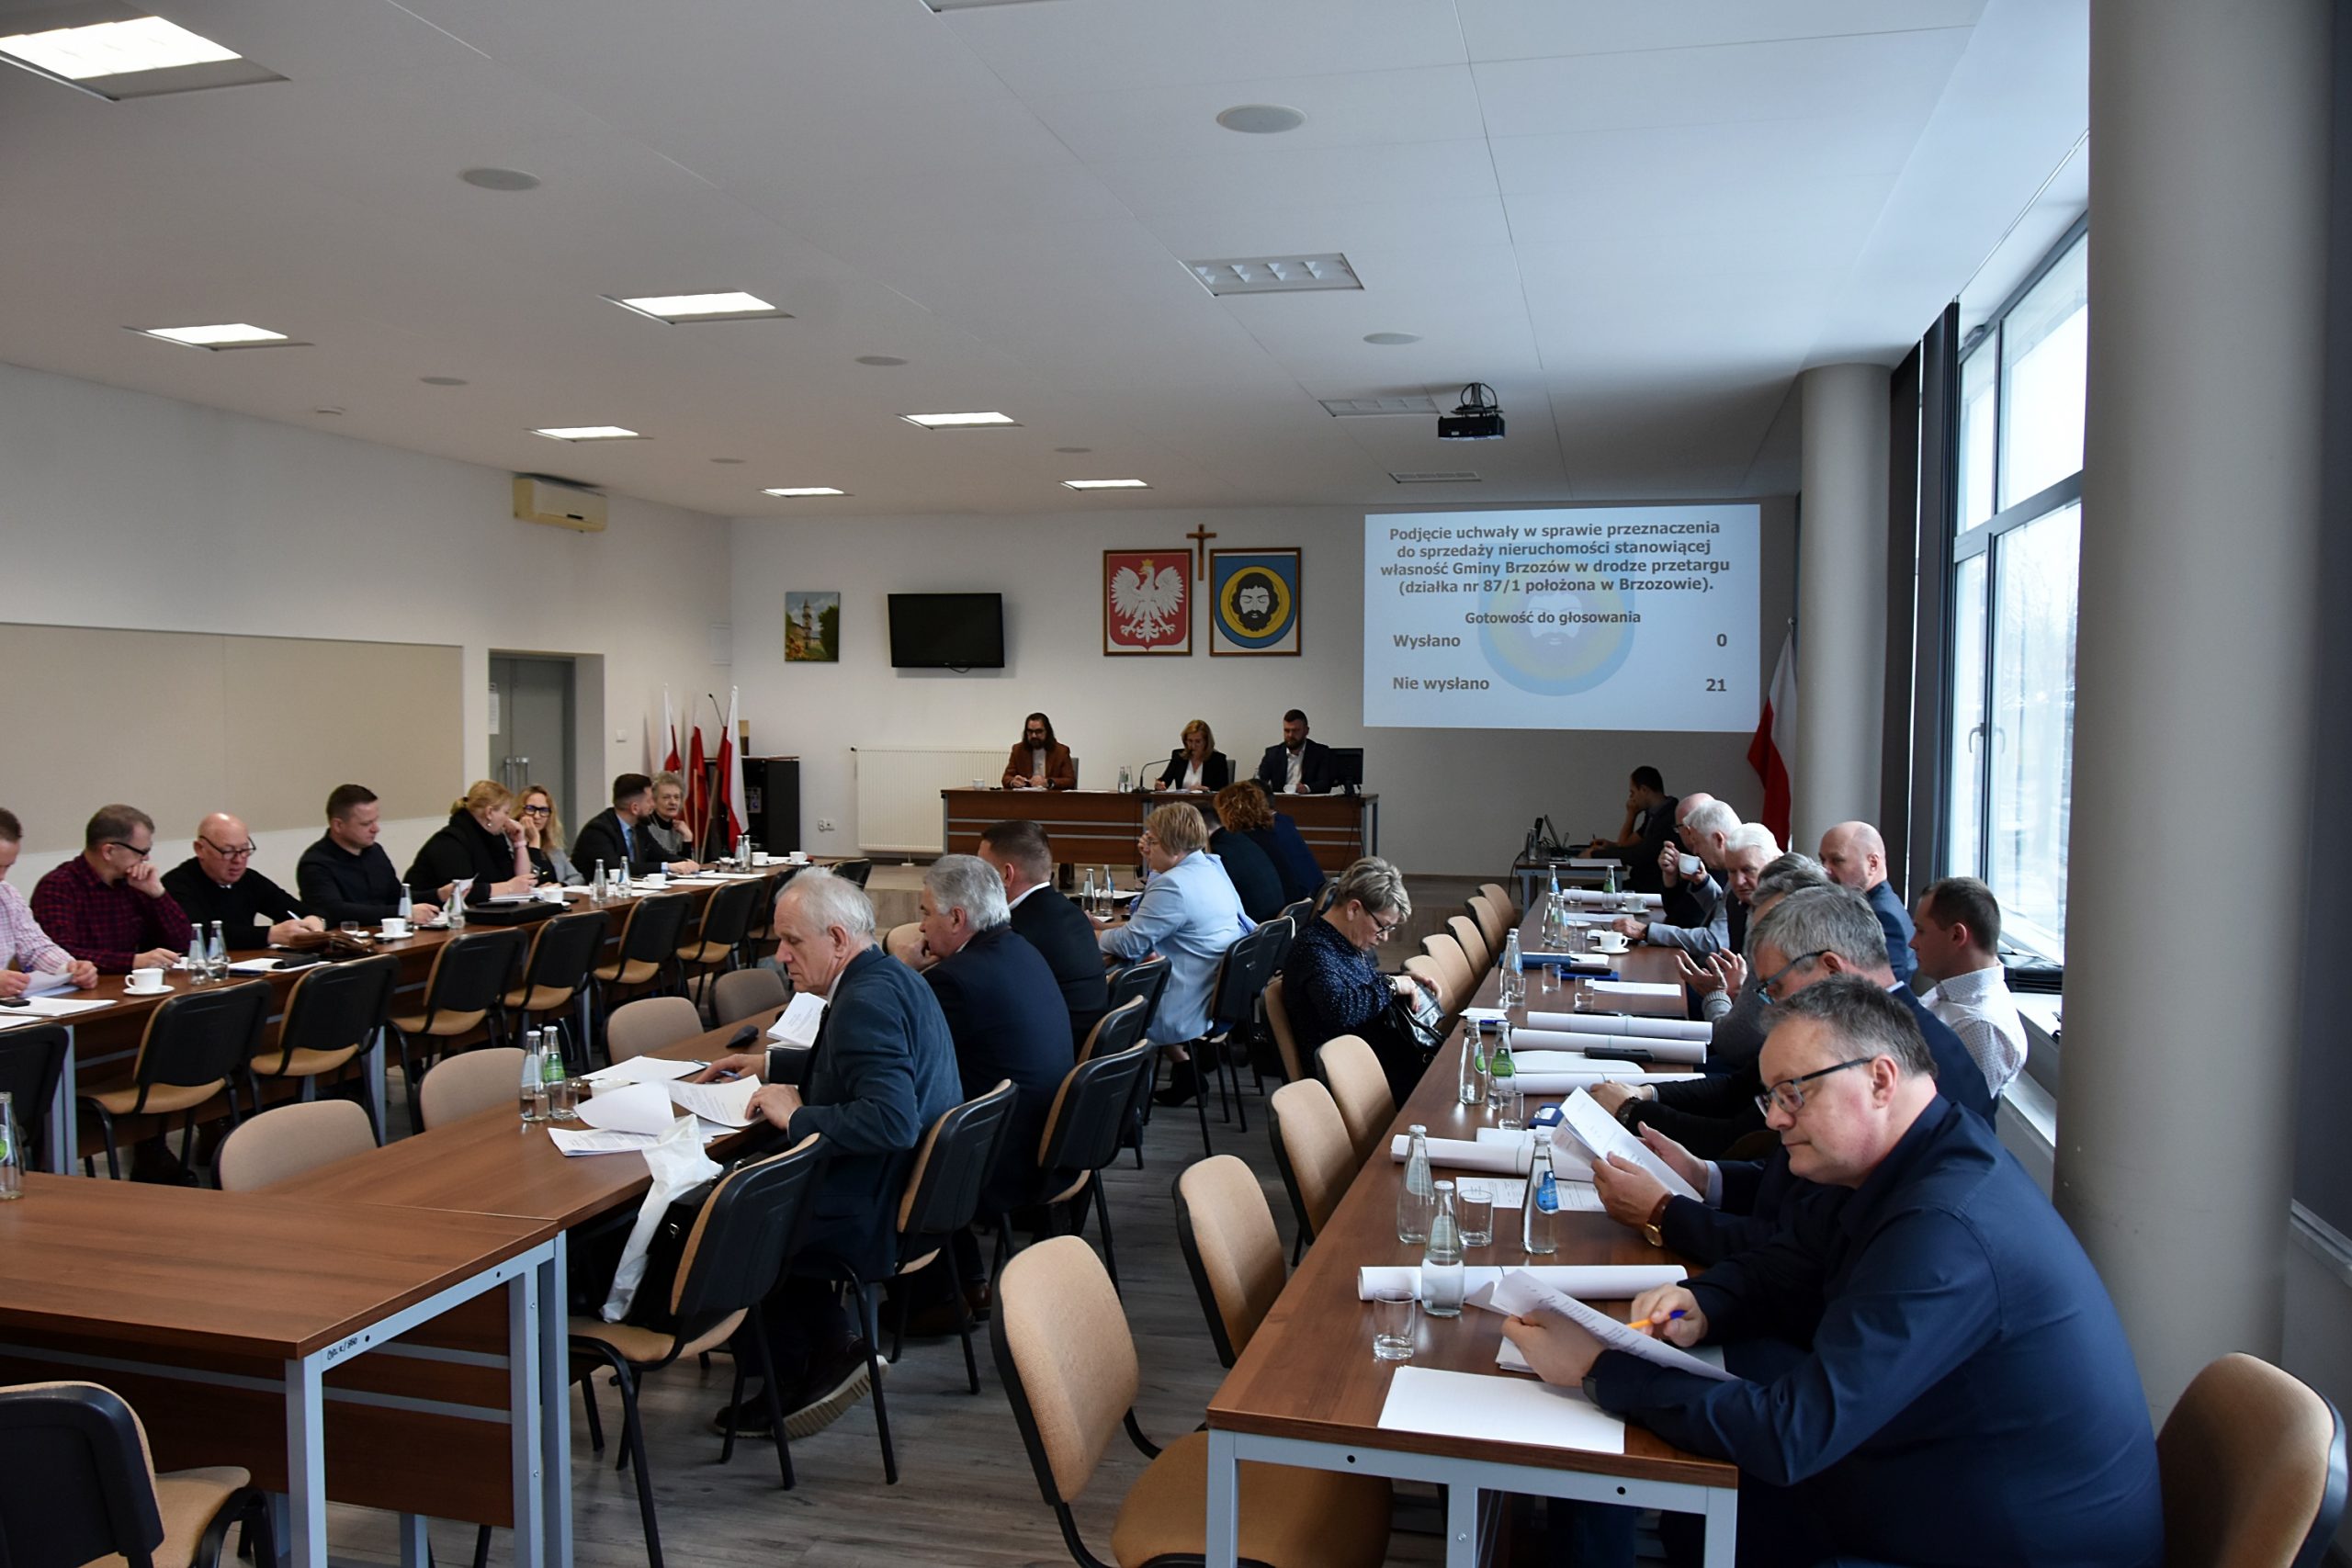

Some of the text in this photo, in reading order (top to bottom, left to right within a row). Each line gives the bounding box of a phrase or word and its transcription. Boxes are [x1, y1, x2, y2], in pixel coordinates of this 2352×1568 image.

[1389, 520, 1720, 543] Podjęcie uchwały w sprawie przeznaczenia
[1396, 539, 1711, 560] do sprzedaży nieruchomości stanowiącej
[1380, 558, 1730, 577] własność Gminy Brzozów w drodze przetargu
[1398, 577, 1713, 596] (działka nr 87/1 położona w Brzozowie).
[1464, 610, 1641, 626] Gotowość do głosowania
[1393, 634, 1461, 650] Wysłano
[1716, 633, 1728, 648] 0
[1393, 676, 1490, 694] Nie wysłano
[1705, 678, 1727, 693] 21
